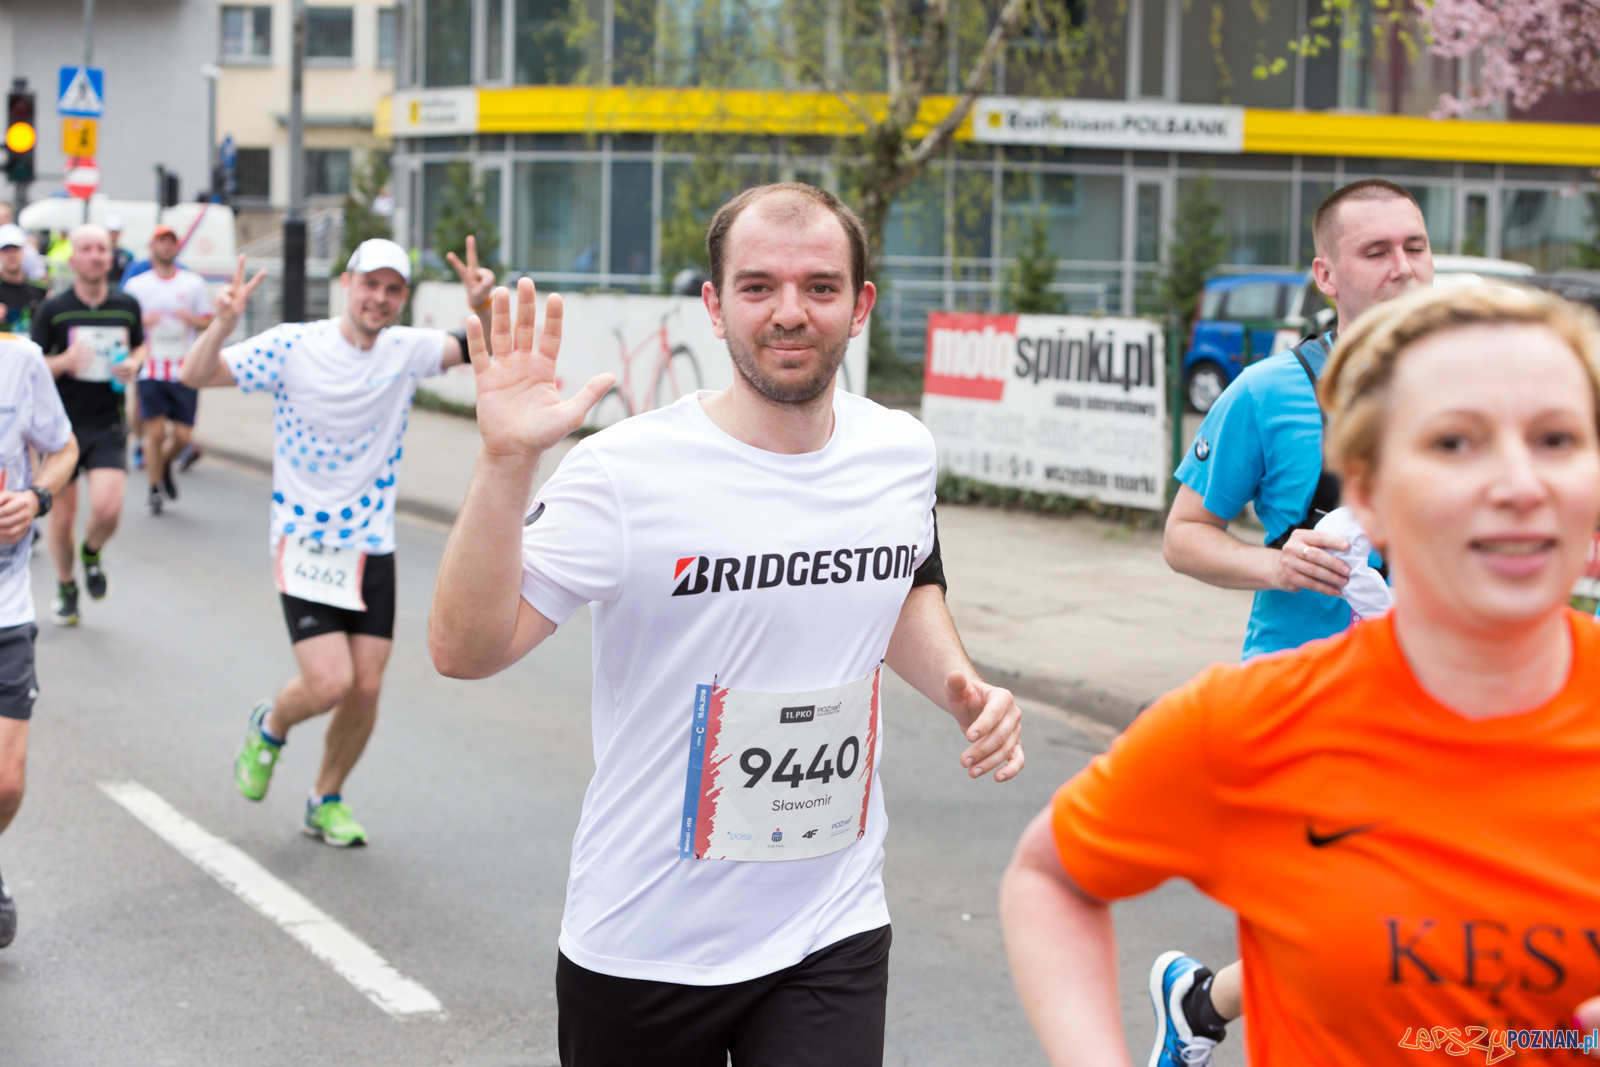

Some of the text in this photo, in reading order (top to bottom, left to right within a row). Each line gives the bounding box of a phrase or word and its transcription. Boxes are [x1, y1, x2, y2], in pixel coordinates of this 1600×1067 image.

[294, 562, 347, 588] 4262
[795, 709, 812, 719] PKO
[739, 735, 860, 789] 9440
[771, 794, 833, 812] Sławomir
[1384, 916, 1600, 1008] KĘS
